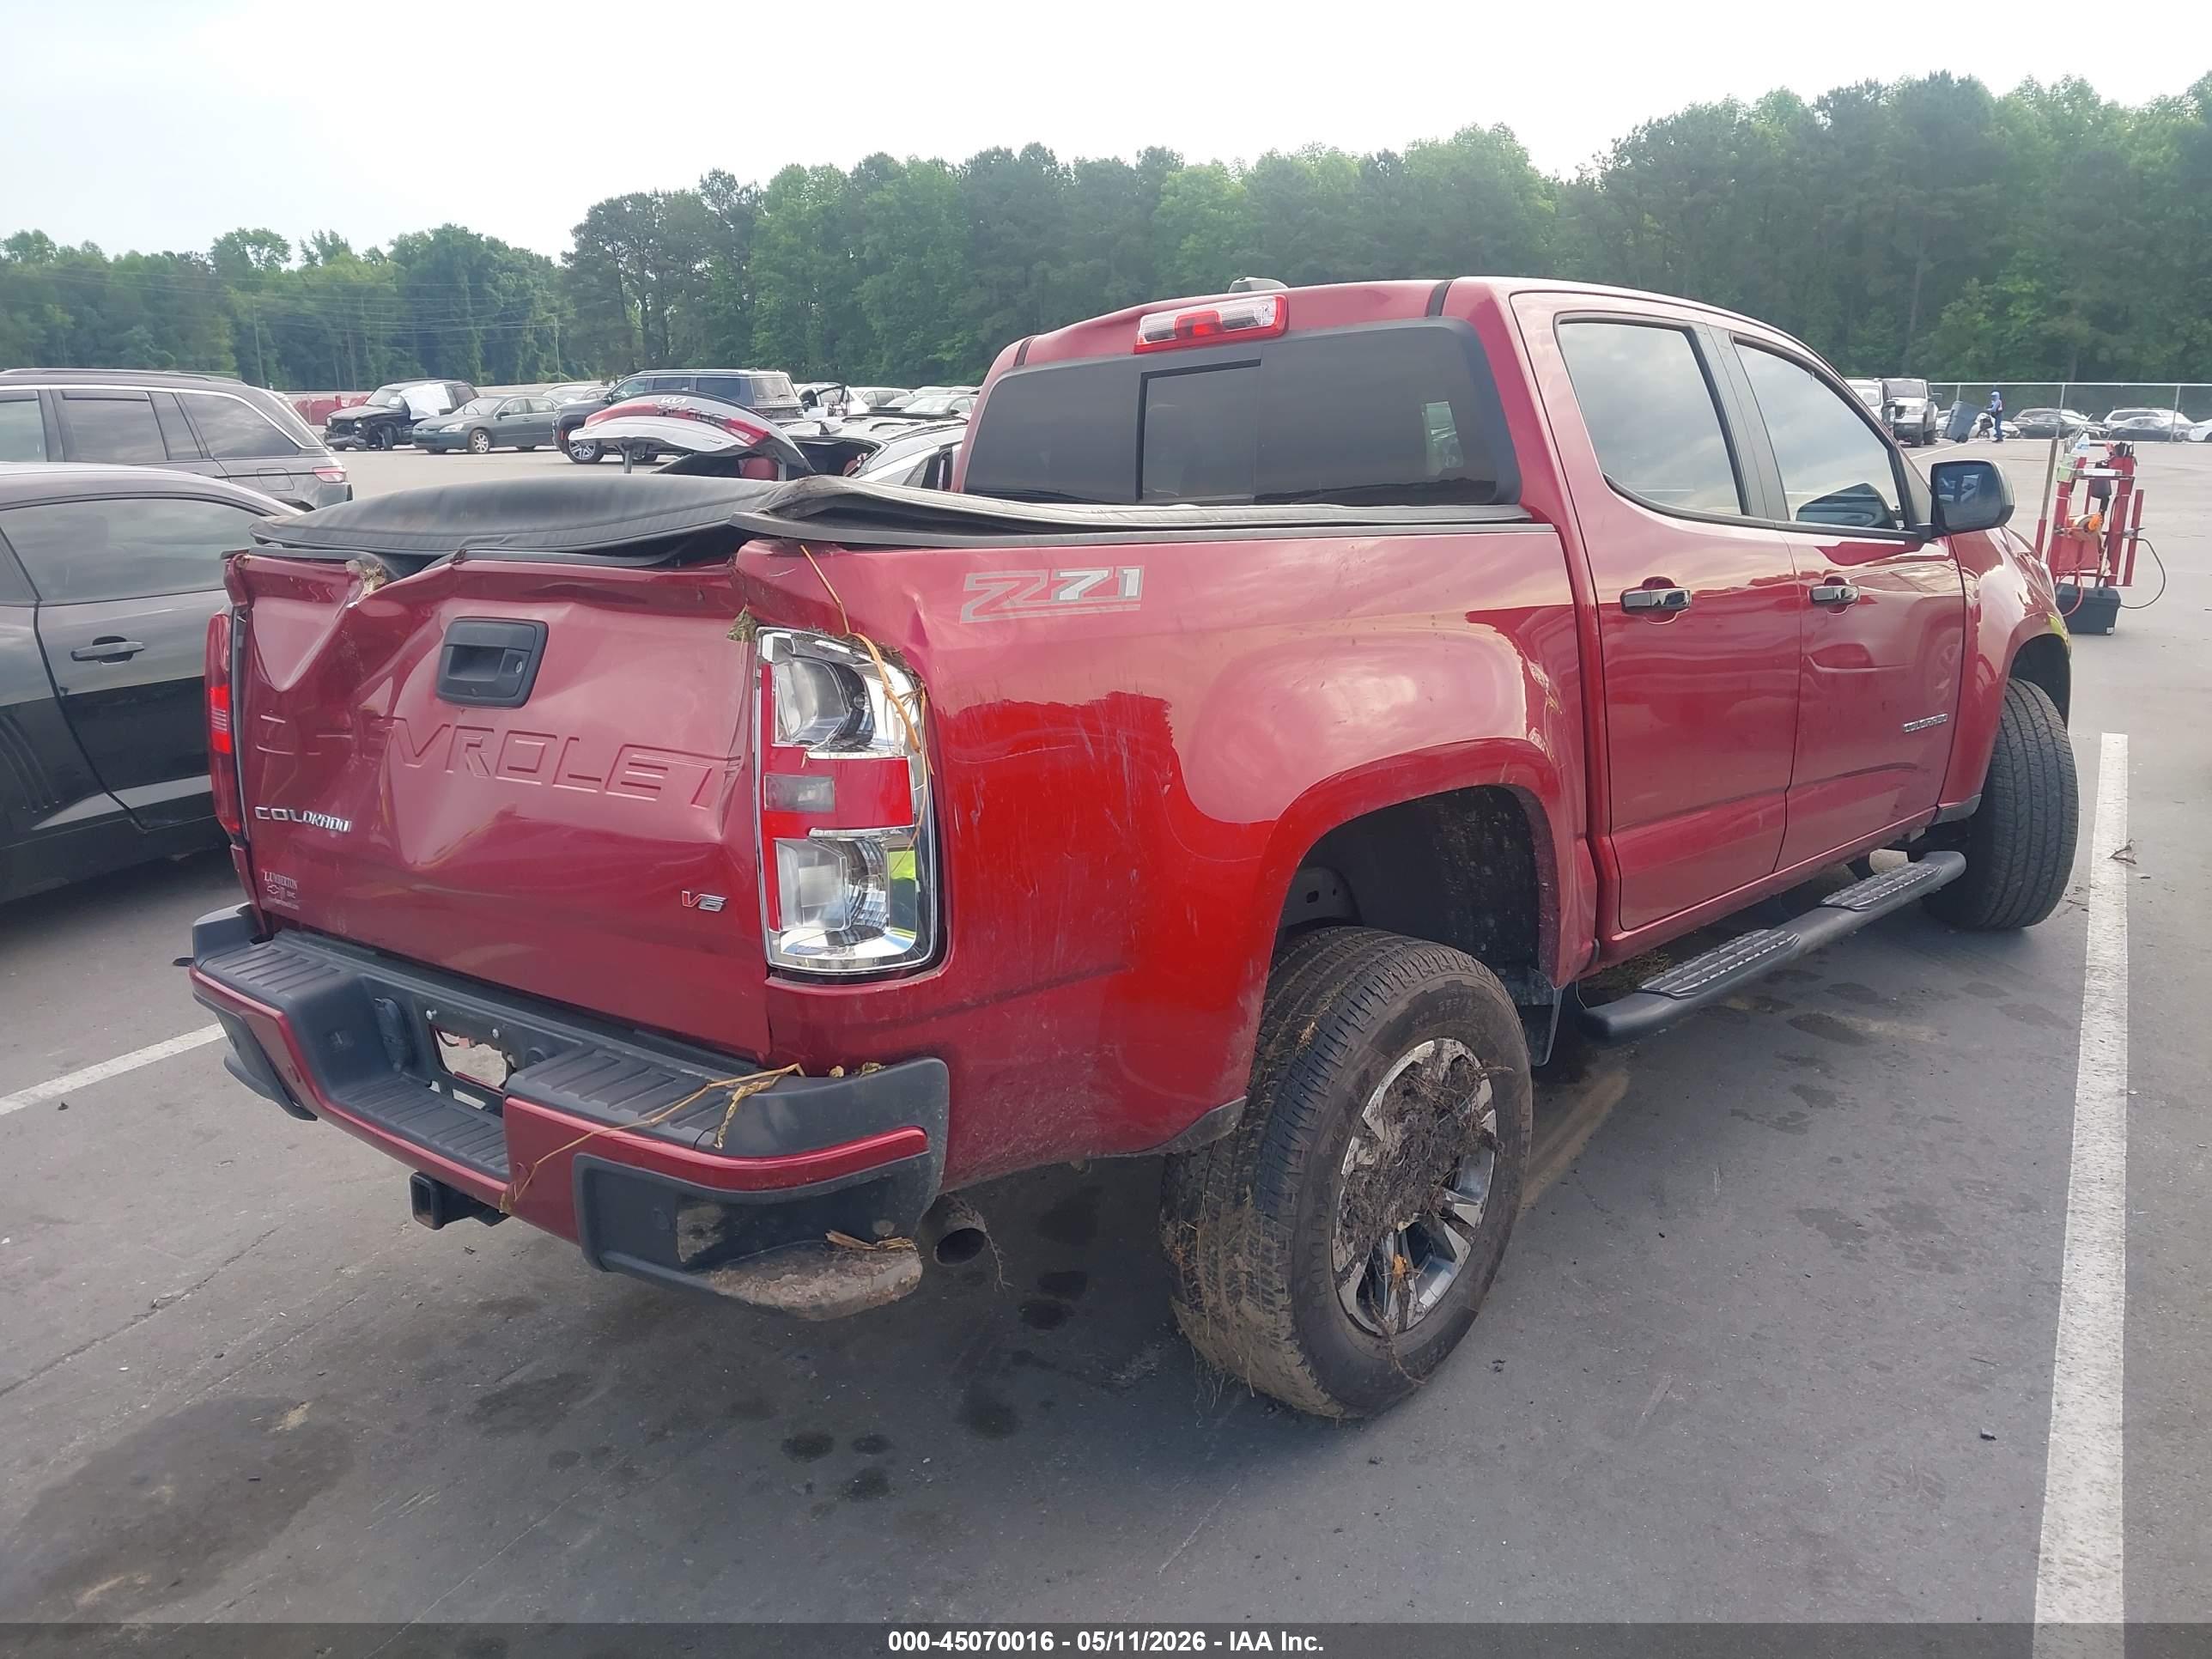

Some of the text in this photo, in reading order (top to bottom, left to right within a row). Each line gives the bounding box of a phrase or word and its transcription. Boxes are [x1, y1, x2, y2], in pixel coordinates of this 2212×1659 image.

[958, 564, 1146, 624] Z71
[256, 712, 745, 811] CVROLET
[681, 890, 728, 912] V6
